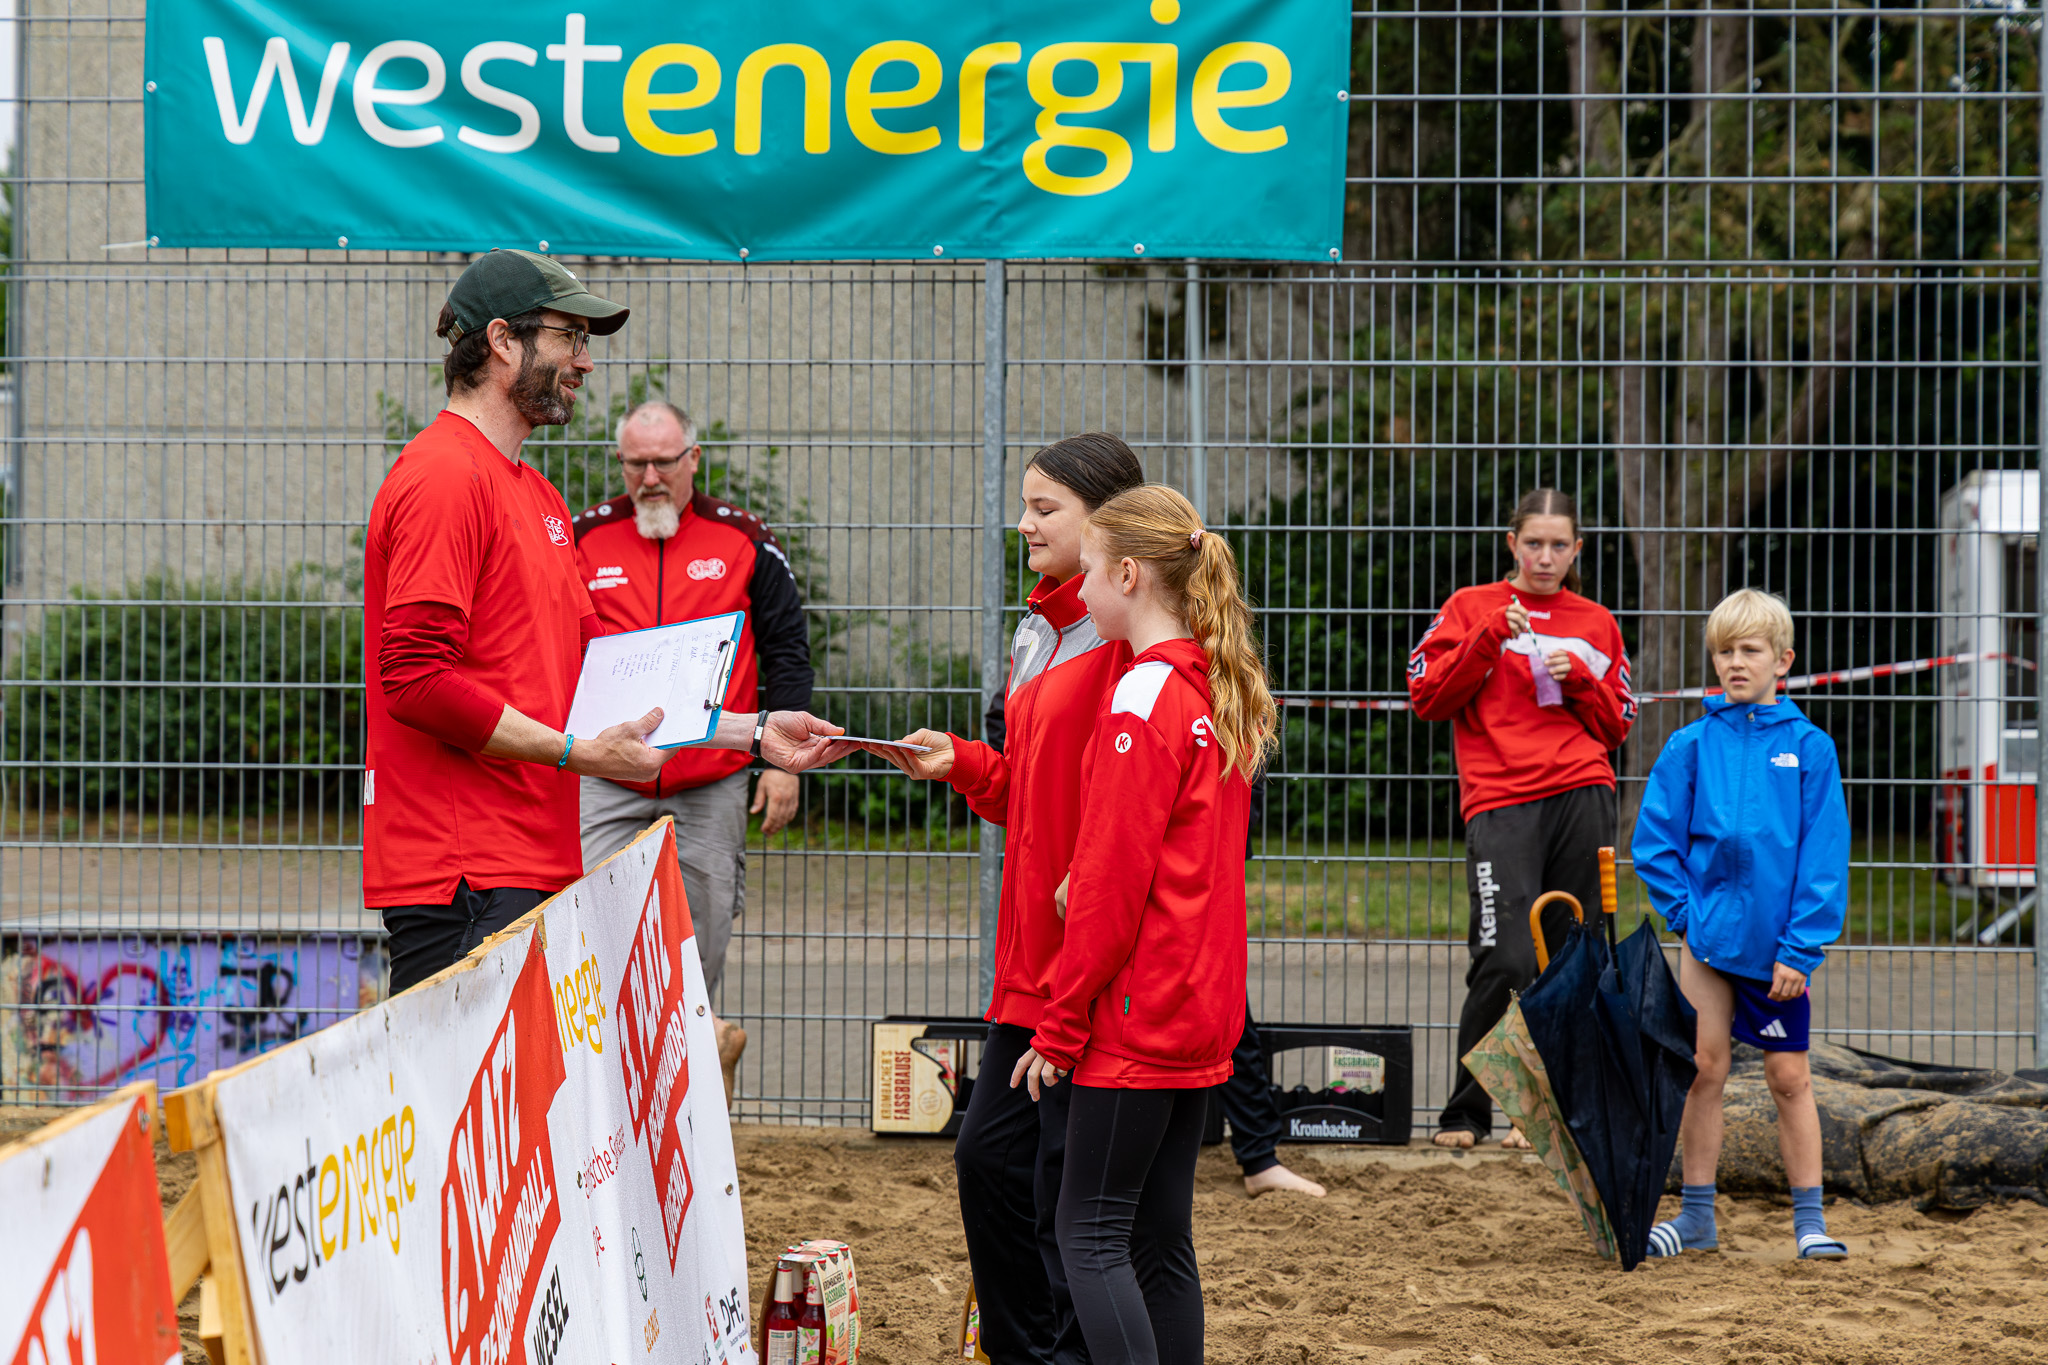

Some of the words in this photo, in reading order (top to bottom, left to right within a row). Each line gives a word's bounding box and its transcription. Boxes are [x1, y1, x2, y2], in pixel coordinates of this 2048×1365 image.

[203, 0, 1292, 197] westenergie
[1476, 861, 1501, 947] Kempa
[552, 931, 606, 1054] nergie
[630, 878, 672, 1081] PLATZ
[894, 1050, 911, 1120] FASSBRAUSE
[1290, 1119, 1362, 1138] Krombacher
[456, 1008, 521, 1302] PLATZ
